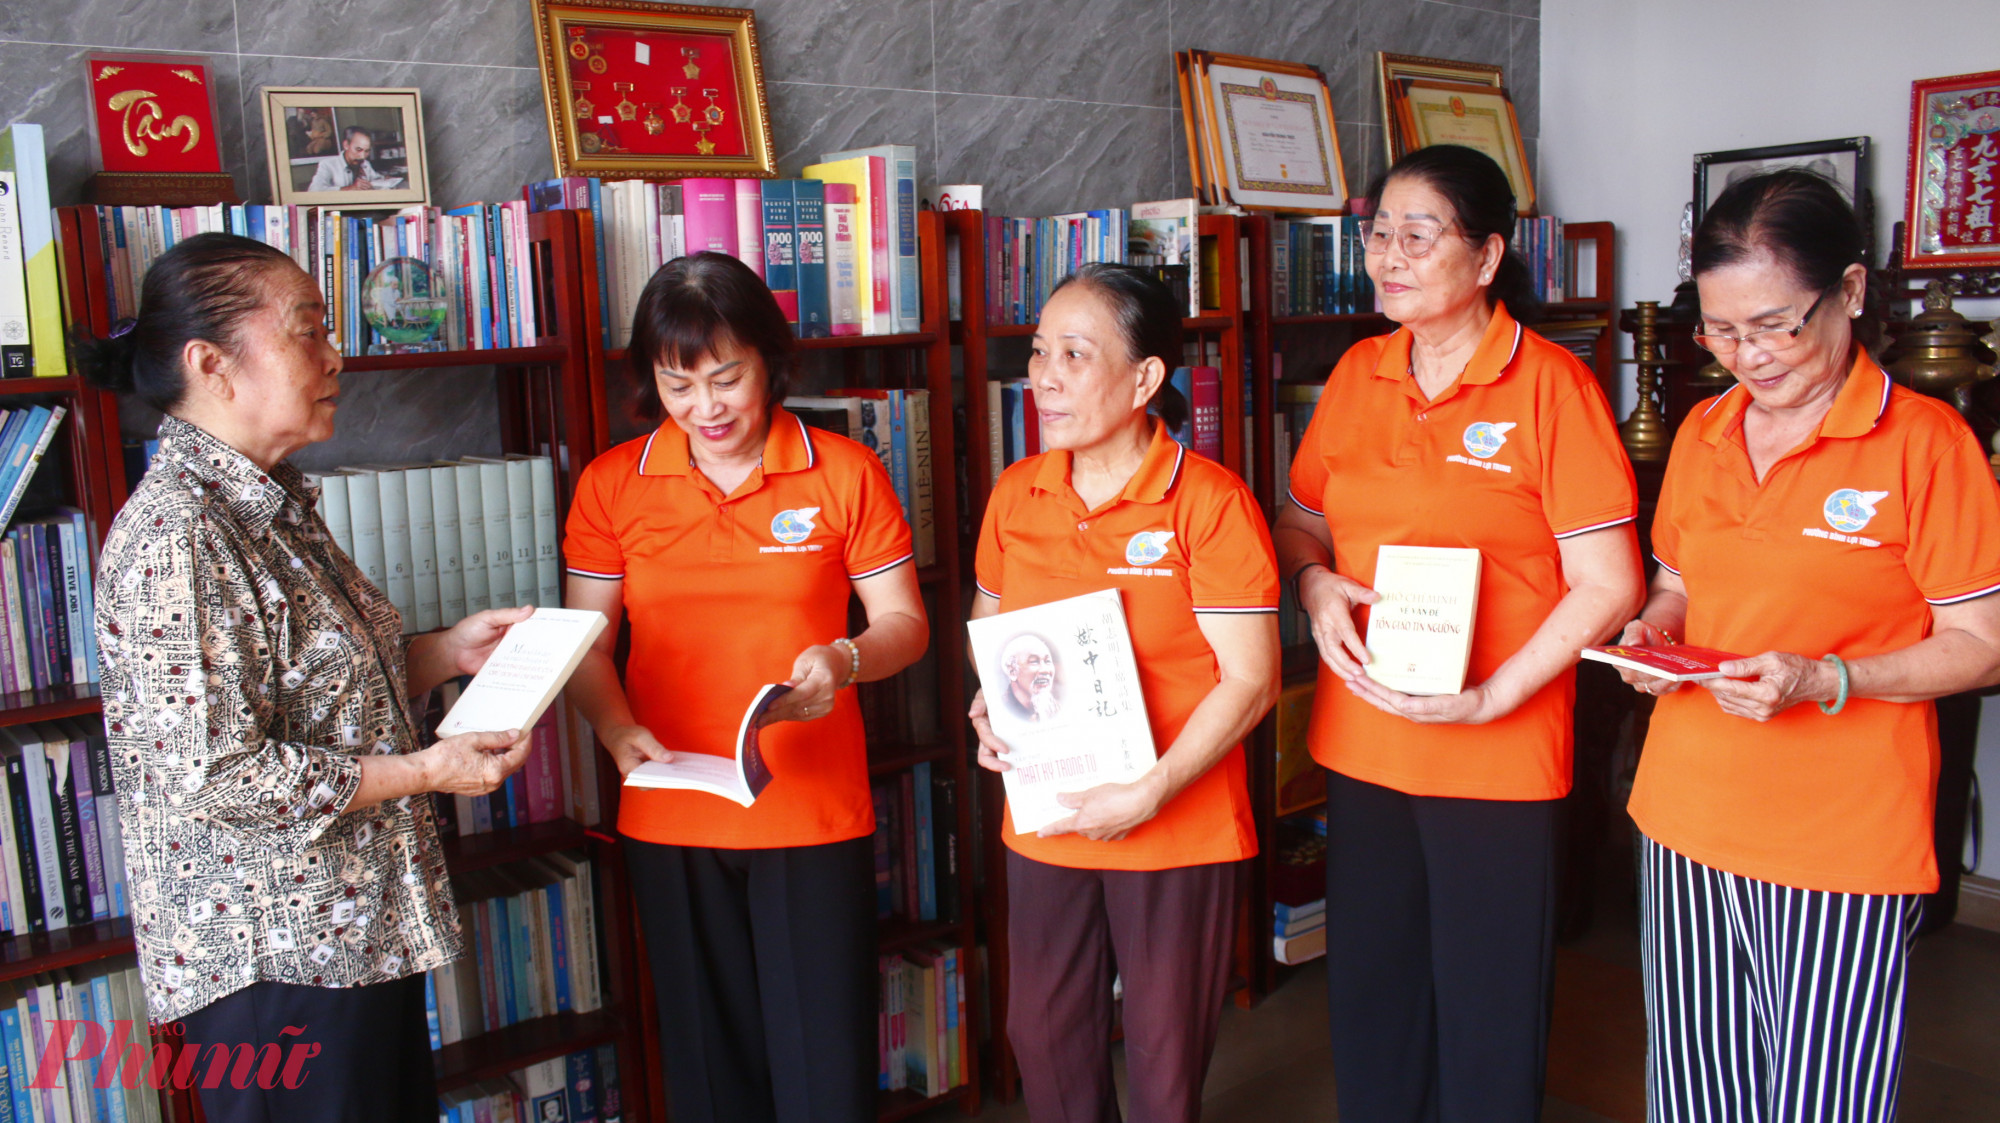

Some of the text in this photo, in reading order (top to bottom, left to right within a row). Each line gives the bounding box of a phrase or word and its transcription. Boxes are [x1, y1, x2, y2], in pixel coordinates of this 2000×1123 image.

[767, 232, 792, 244] 1000
[799, 231, 823, 243] 1000
[836, 232, 852, 242] Minh
[1492, 462, 1512, 473] TRUNG
[1802, 528, 1829, 539] PHƯỜNG
[1829, 532, 1846, 542] BÌNH
[496, 551, 509, 561] 10
[517, 547, 530, 558] 11
[541, 545, 553, 555] 12
[424, 559, 431, 569] 7
[449, 557, 456, 567] 8
[472, 554, 480, 564] 9
[395, 563, 403, 573] 6
[66, 565, 78, 613] STEVE JOBS
[1428, 593, 1457, 605] MINH
[95, 749, 106, 763] MY
[1055, 755, 1084, 779] TRONG
[96, 763, 111, 791] VISION
[76, 796, 96, 820] X6
[65, 825, 75, 838] LÝ
[68, 859, 80, 880] NĂM
